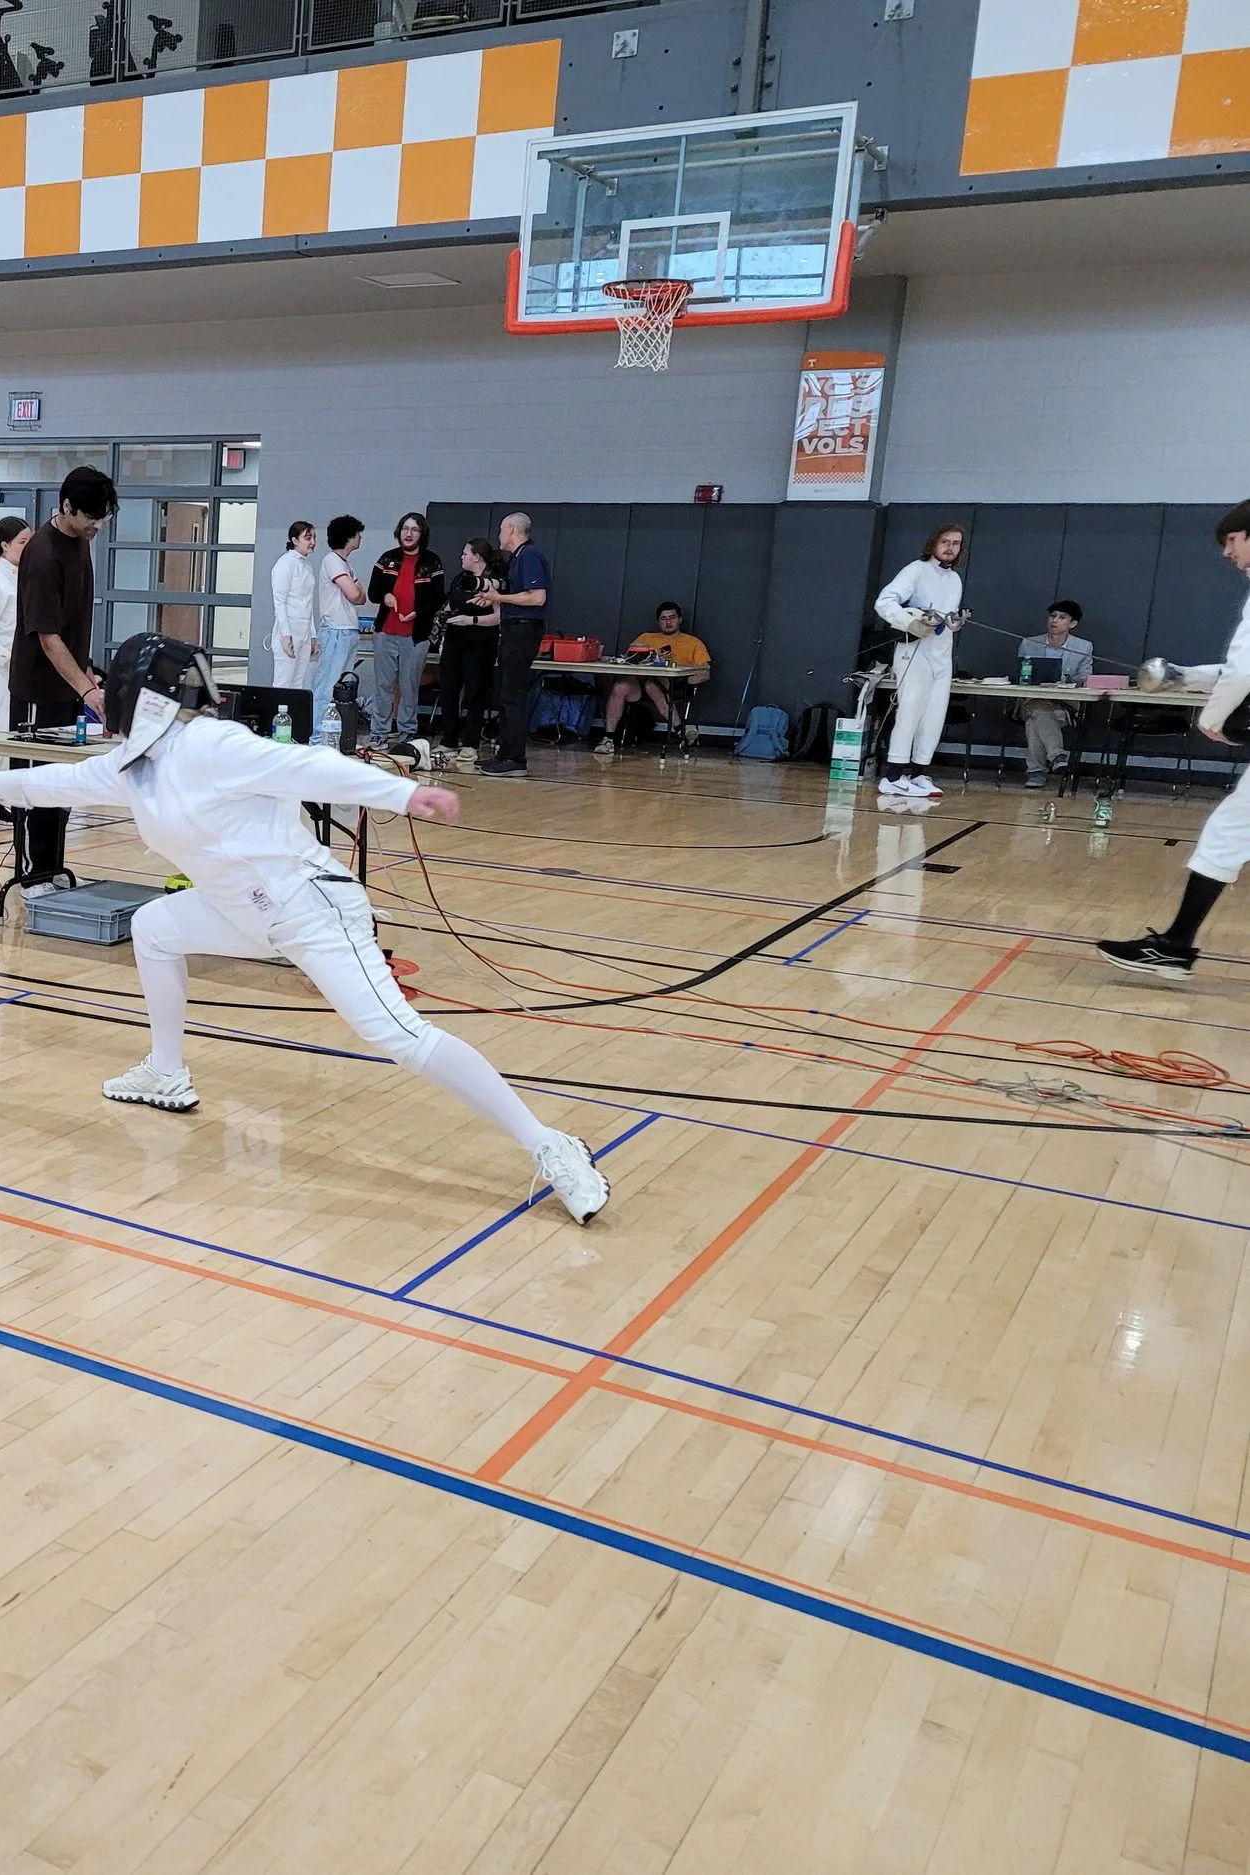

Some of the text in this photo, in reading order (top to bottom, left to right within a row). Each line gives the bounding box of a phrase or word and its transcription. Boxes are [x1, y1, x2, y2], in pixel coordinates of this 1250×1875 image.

[16, 401, 34, 418] EXIT
[803, 417, 867, 437] ECT
[801, 436, 865, 455] VOLS
